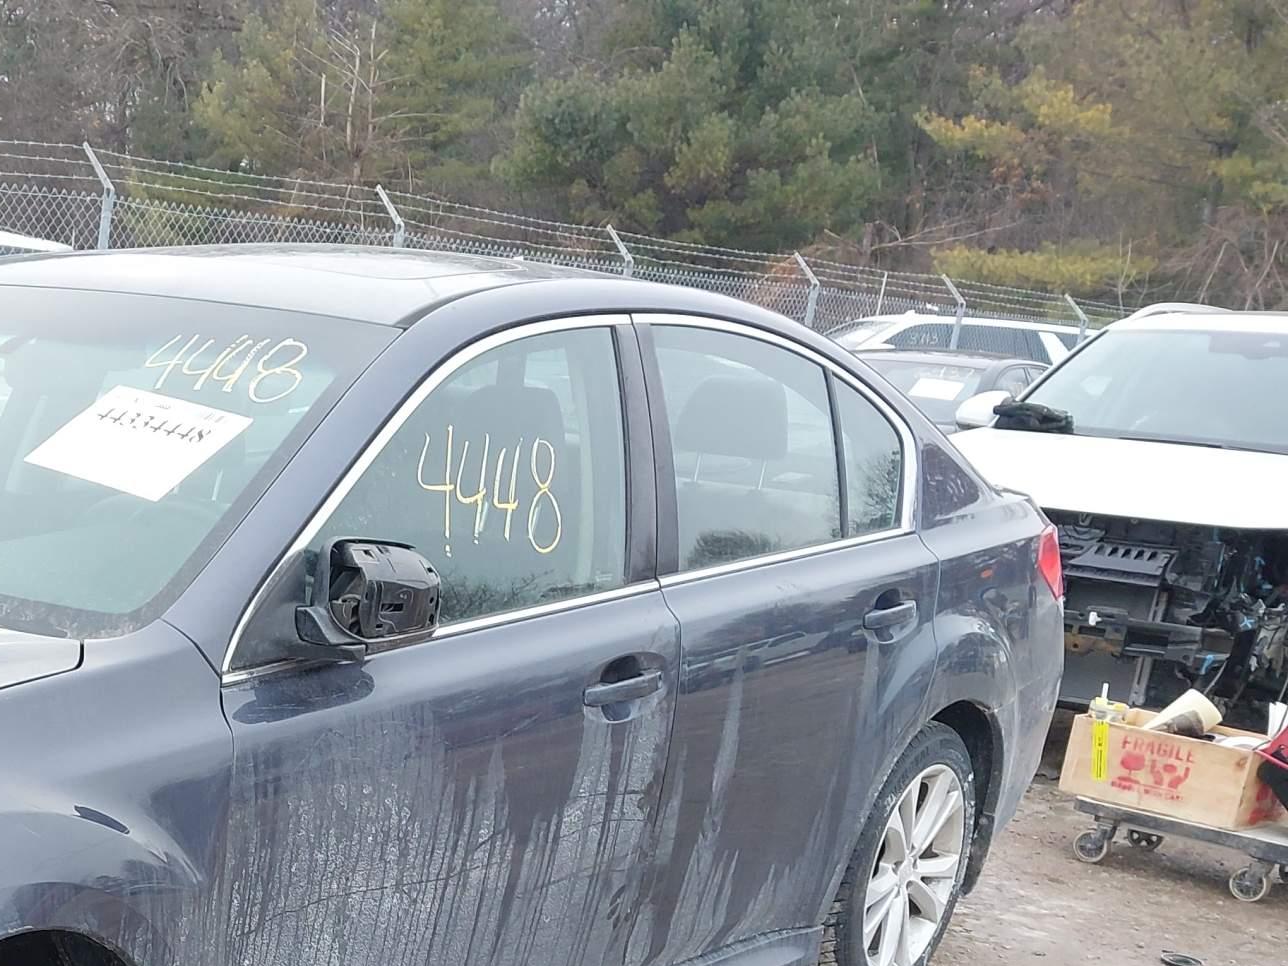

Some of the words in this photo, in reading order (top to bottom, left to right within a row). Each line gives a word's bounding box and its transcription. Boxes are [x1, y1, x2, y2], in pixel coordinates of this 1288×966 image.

[97, 407, 212, 443] 44334448
[417, 424, 562, 557] 4448
[1121, 735, 1195, 764] FRAGILE
